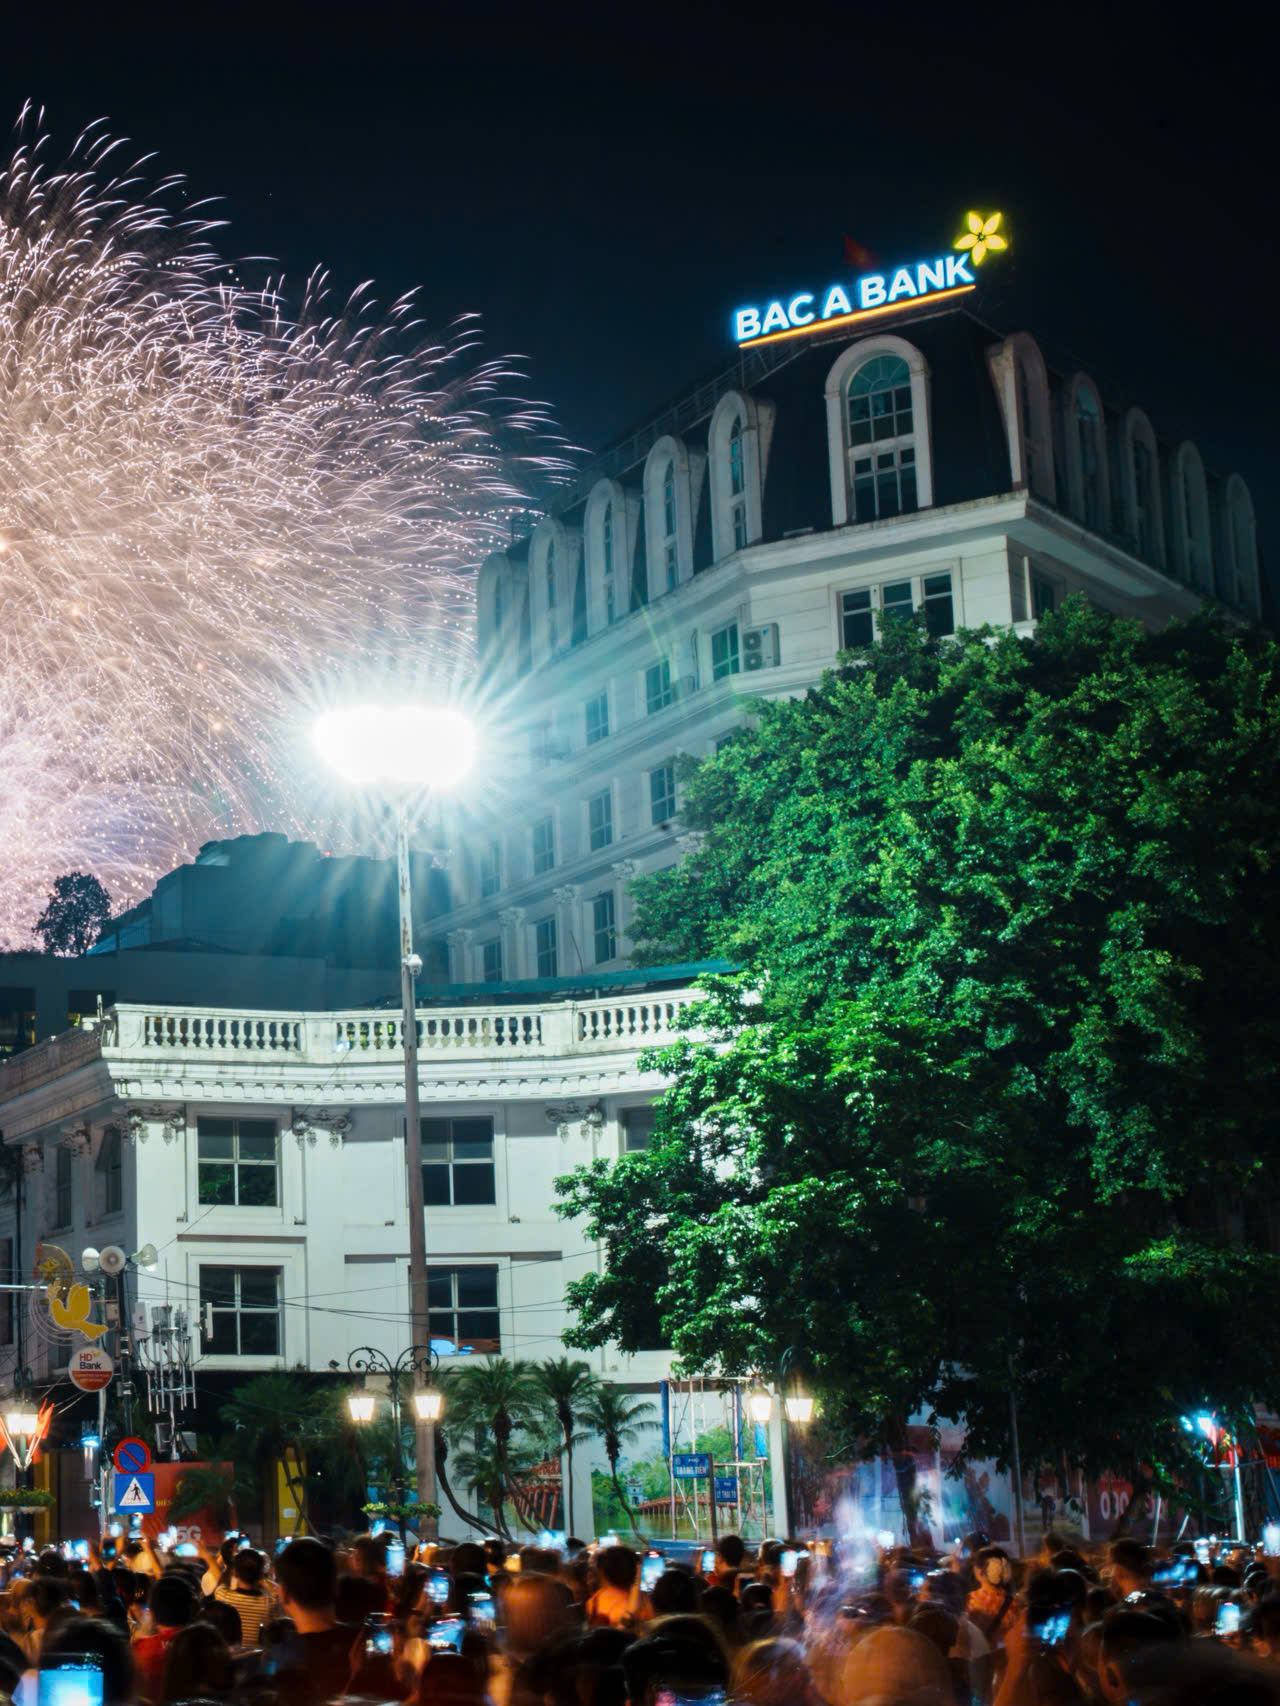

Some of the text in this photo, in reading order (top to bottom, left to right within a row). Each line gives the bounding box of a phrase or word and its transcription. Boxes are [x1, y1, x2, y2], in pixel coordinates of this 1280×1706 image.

[736, 253, 974, 341] BAC A BANK
[80, 1353, 93, 1361] HD
